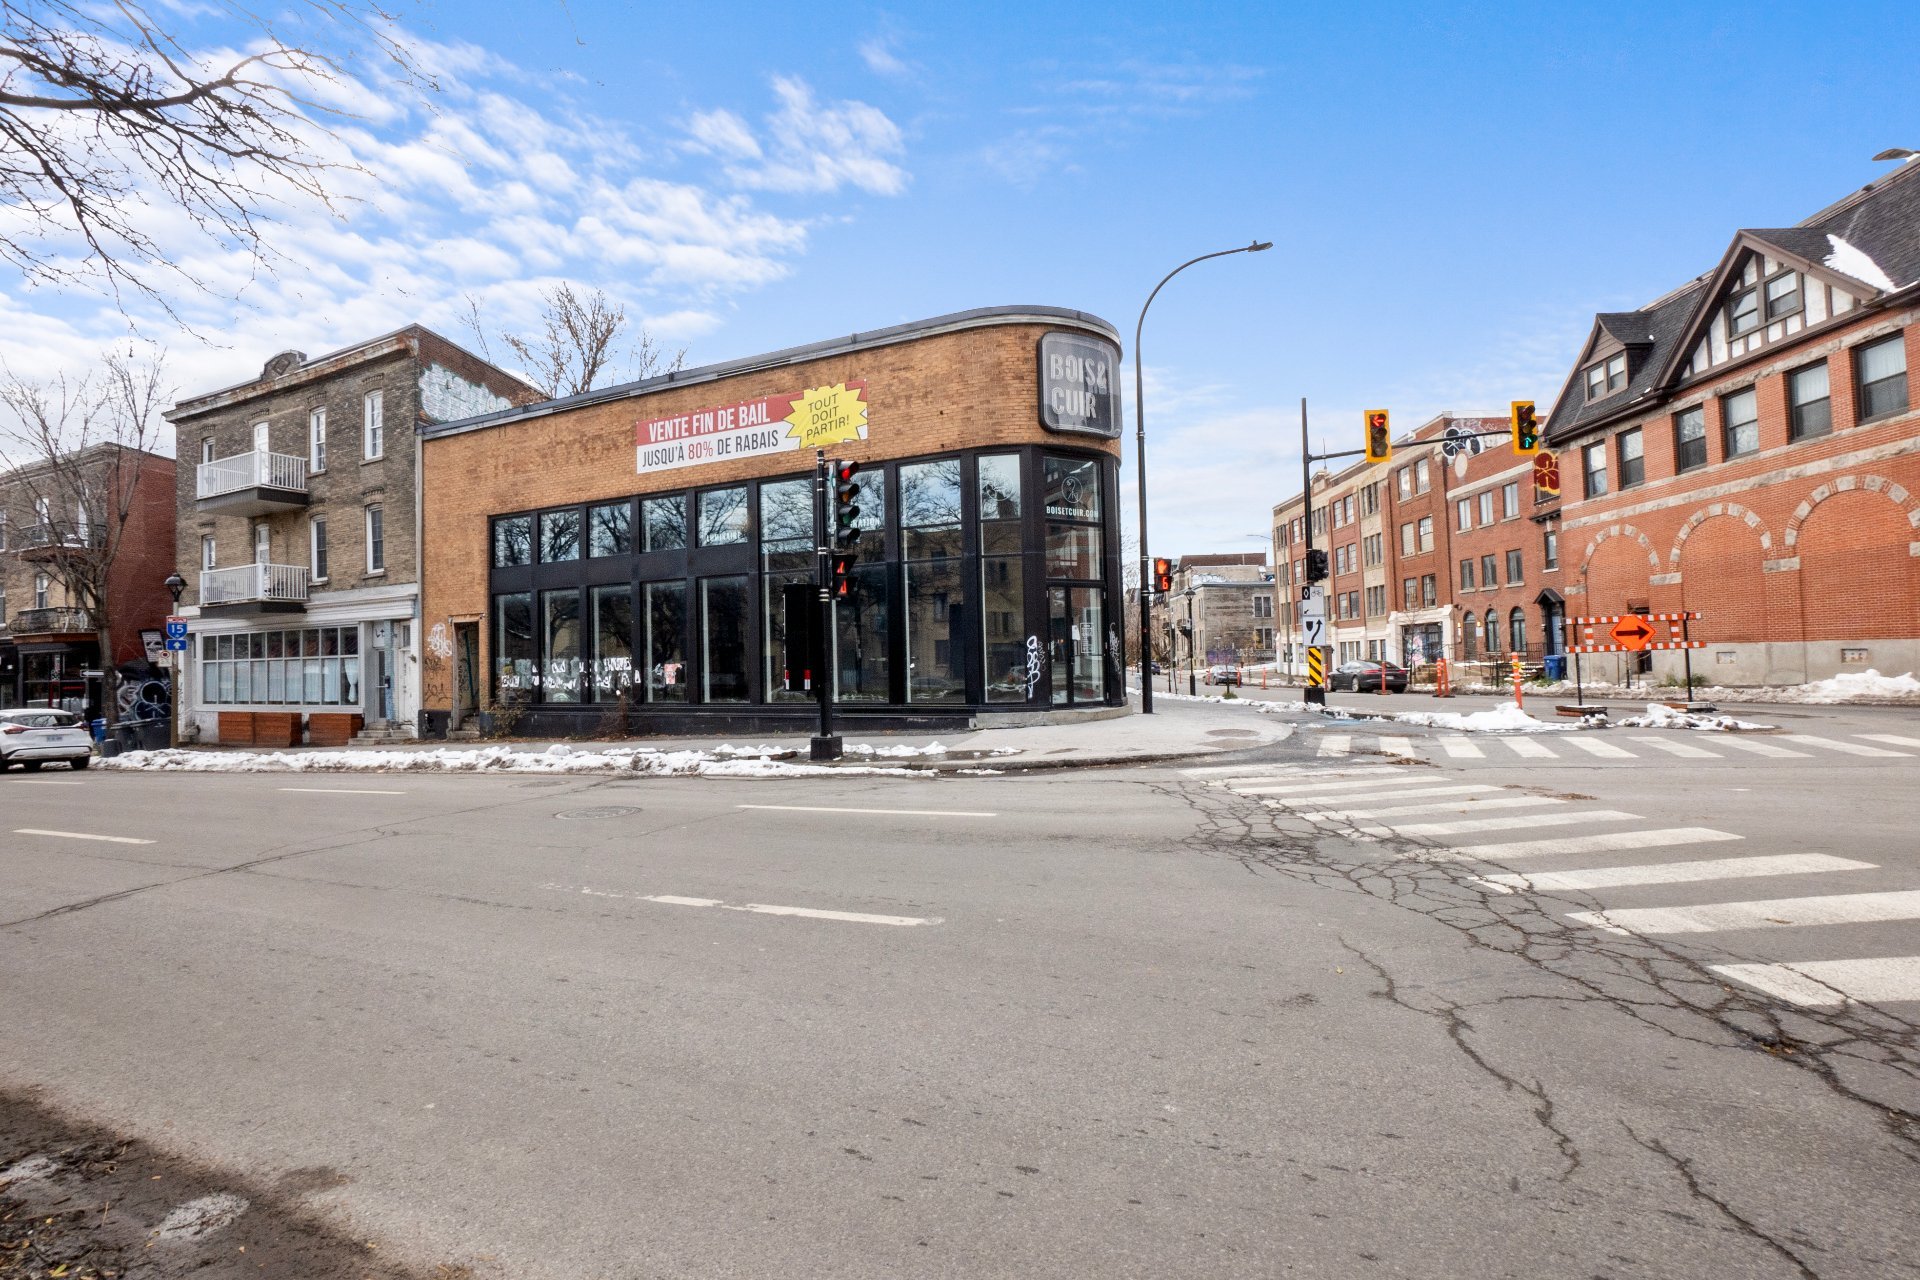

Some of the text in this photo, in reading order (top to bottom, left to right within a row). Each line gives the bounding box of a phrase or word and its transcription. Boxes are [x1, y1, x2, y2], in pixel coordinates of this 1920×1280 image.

[808, 392, 839, 413] TOUT
[1051, 386, 1097, 419] CUIR
[648, 402, 771, 443] VENTE FIN DE BAIL
[811, 405, 839, 425] DOIT
[806, 415, 850, 441] PARTIR!
[642, 429, 779, 468] JUSQU'À 80% DE RABAIS
[1046, 505, 1099, 518] BOISETCUIR.COM
[1162, 576, 1169, 590] 6
[171, 624, 184, 634] 15
